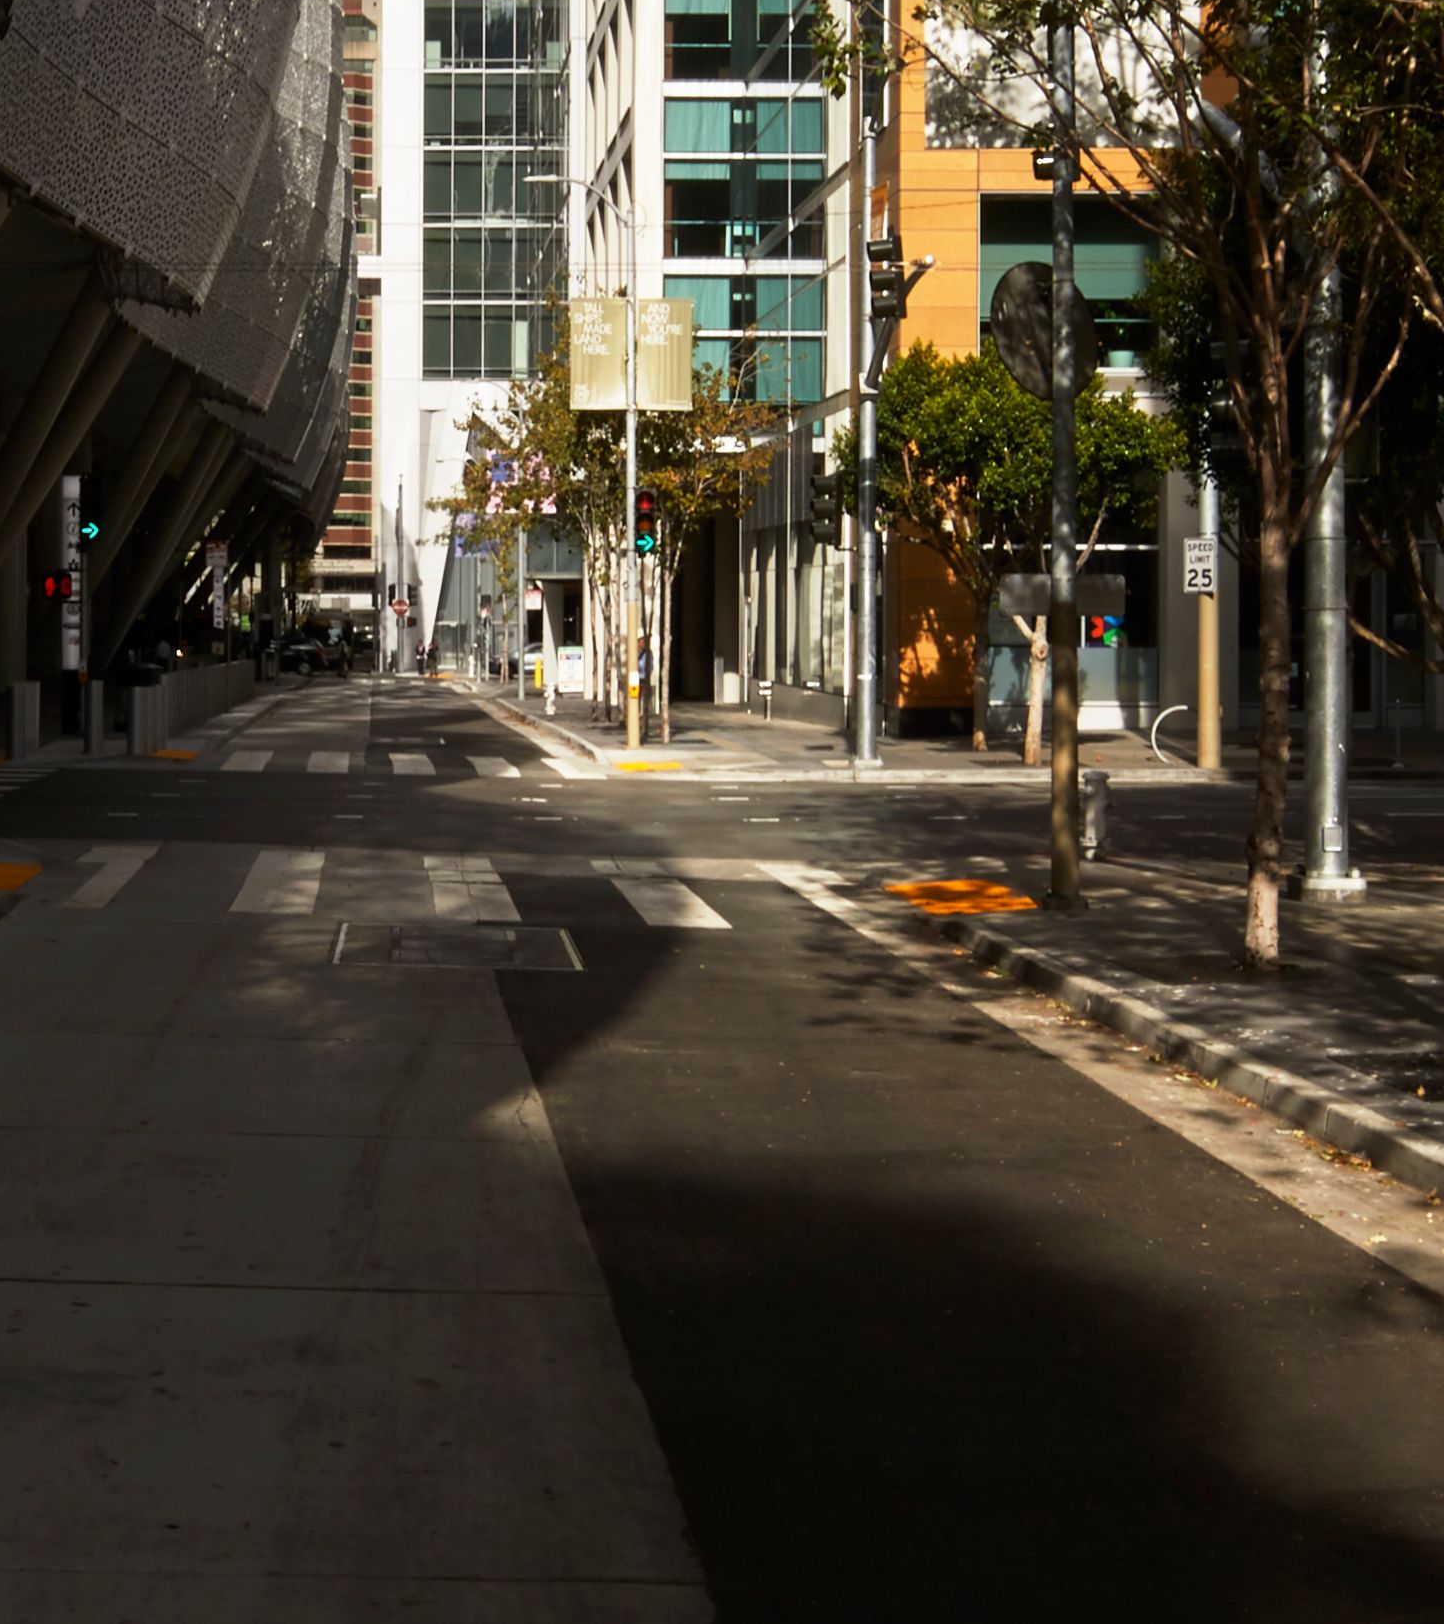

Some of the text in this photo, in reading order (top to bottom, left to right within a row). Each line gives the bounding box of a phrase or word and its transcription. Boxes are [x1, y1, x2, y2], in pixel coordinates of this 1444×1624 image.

[648, 303, 670, 313] AND
[641, 313, 668, 324] NOW
[583, 323, 613, 334] MADE
[573, 334, 602, 344] LAND
[1187, 543, 1213, 552] SPEED
[1189, 555, 1210, 564] LIMIT
[1187, 568, 1212, 587] 25
